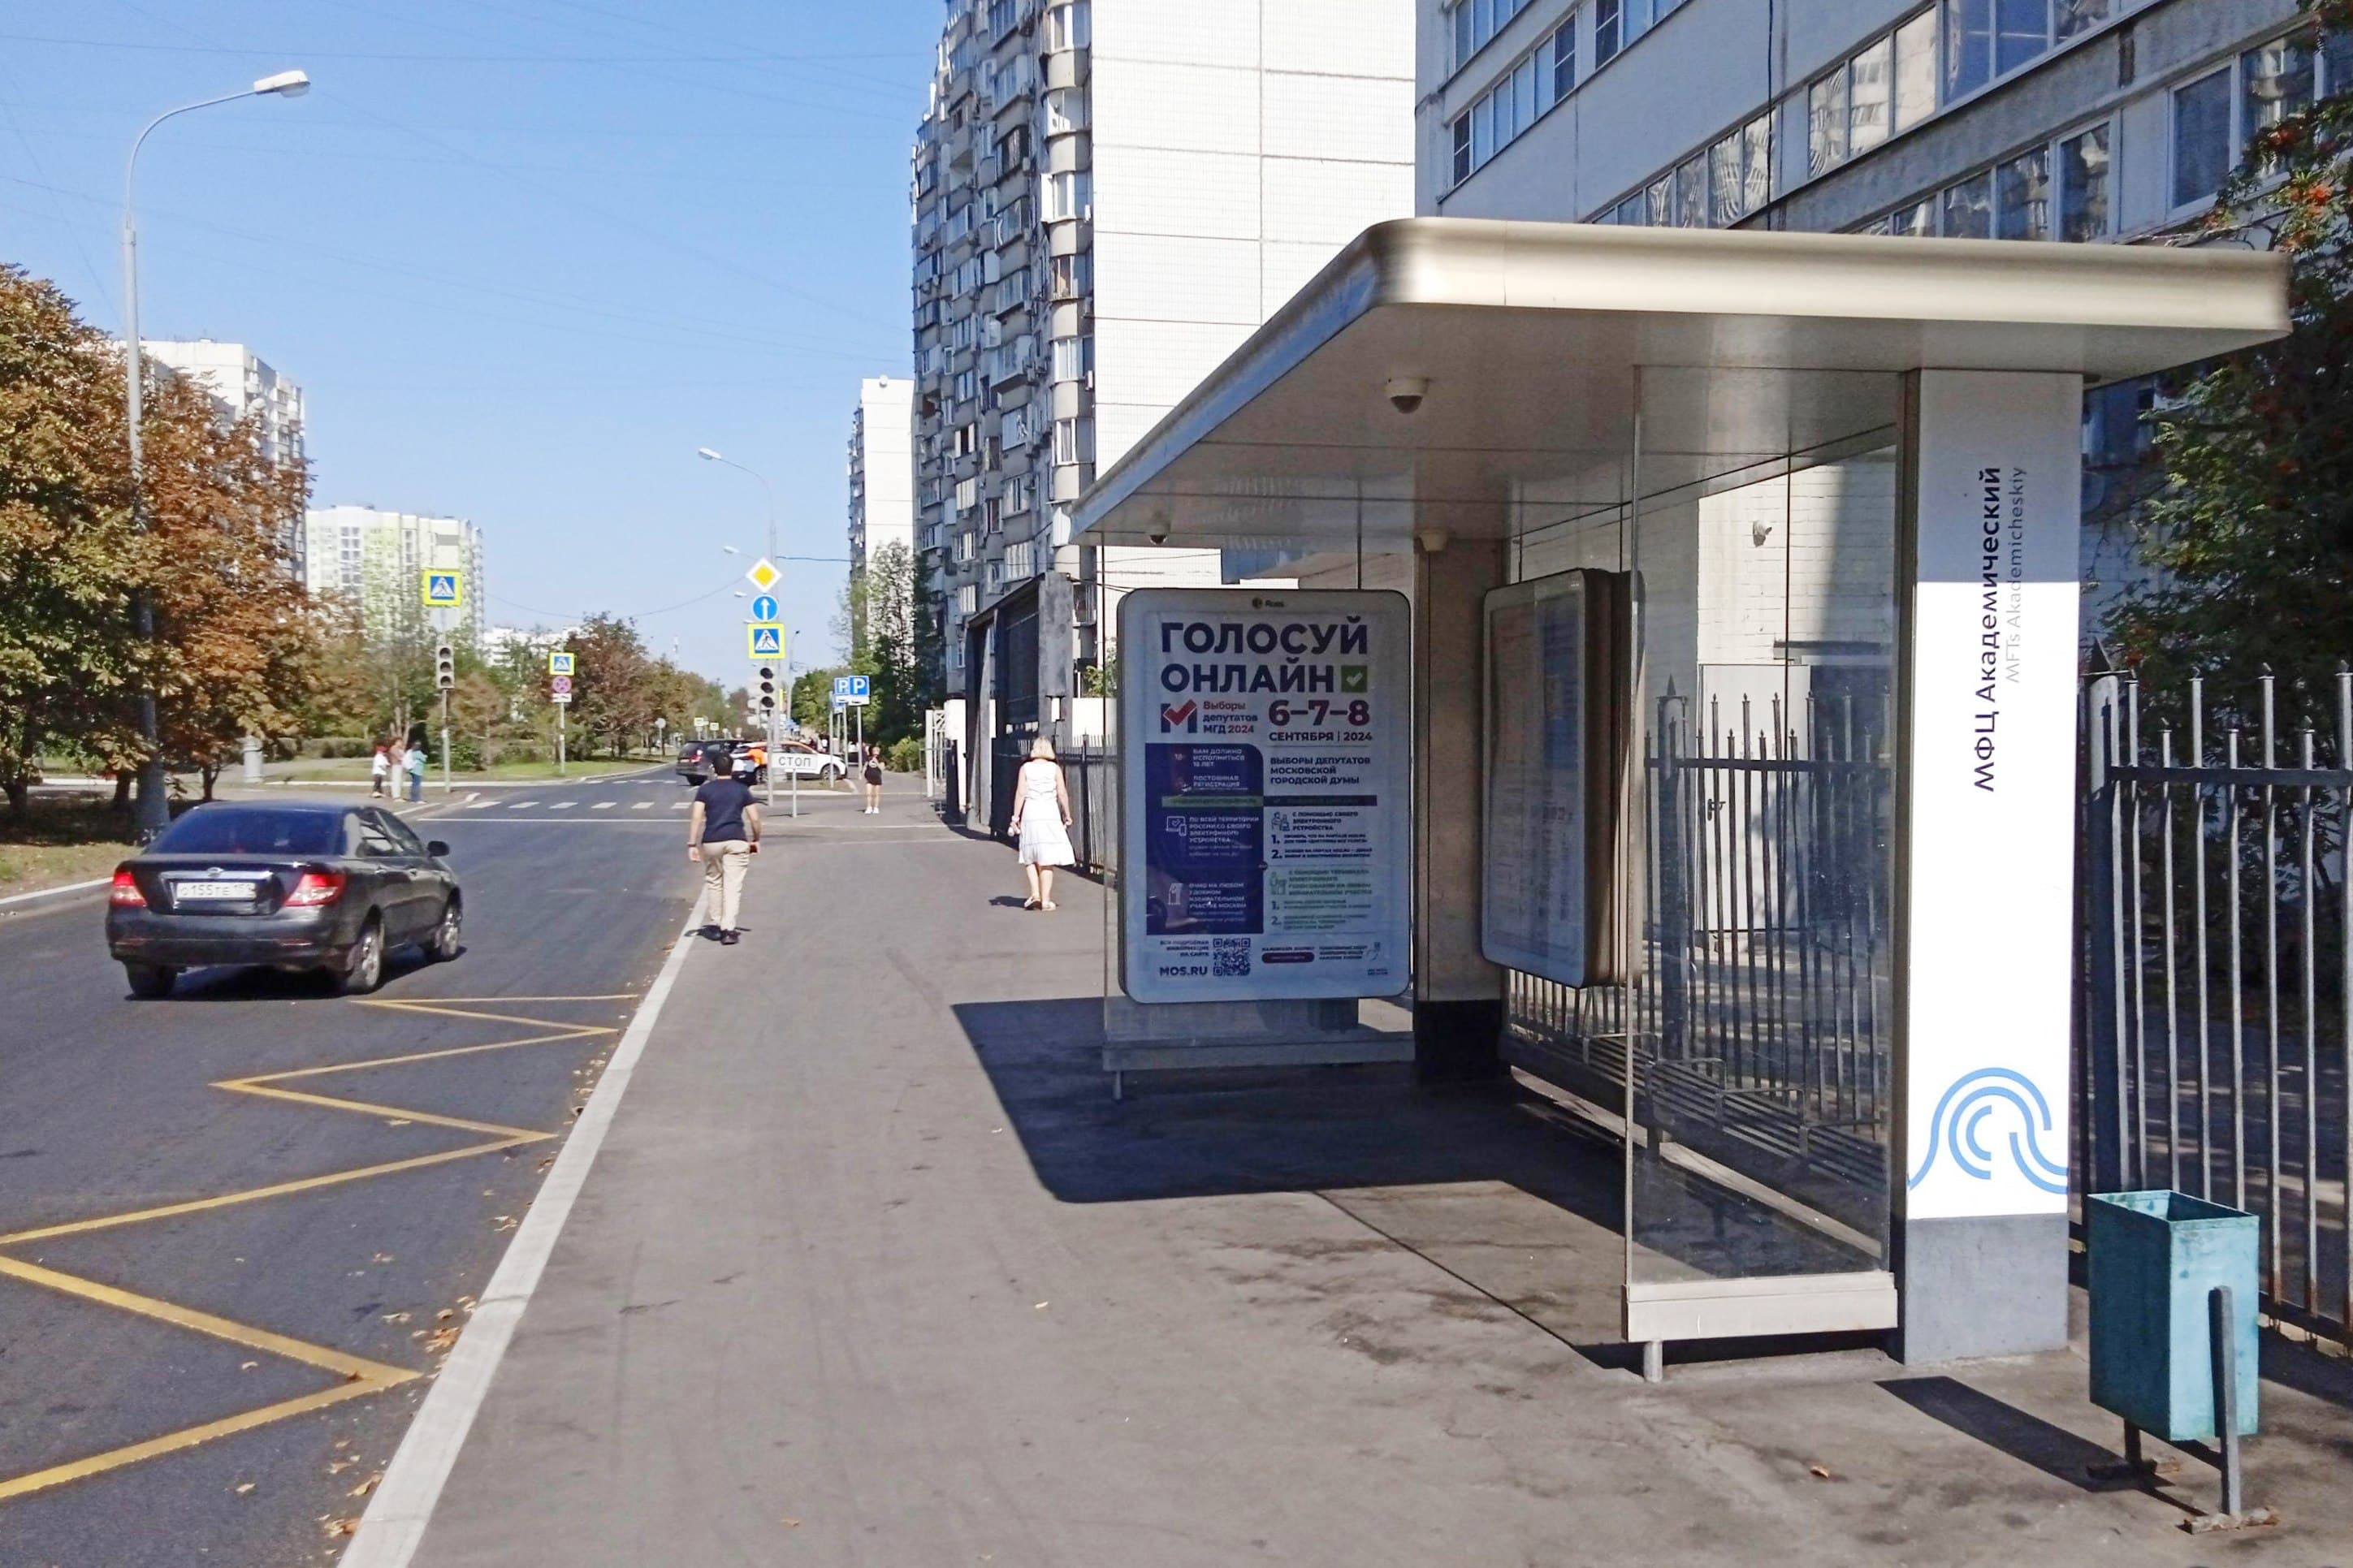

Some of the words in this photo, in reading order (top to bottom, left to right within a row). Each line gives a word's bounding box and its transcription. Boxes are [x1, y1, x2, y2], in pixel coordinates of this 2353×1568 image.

[2005, 467, 2027, 628] Akademicheskiy
[1975, 467, 2000, 702] Академический
[1160, 616, 1369, 654] ГОЛОСУЙ
[2005, 633, 2021, 684] MFTs
[1160, 656, 1334, 693] ОНЛАЙН
[853, 677, 866, 694] P
[1203, 701, 1247, 711] Выборы
[1203, 714, 1259, 724] депутатов
[1203, 724, 1226, 735] МГД
[1227, 724, 1255, 734] 2024
[1269, 731, 1334, 741] СЕНТЯБРЯ
[1343, 731, 1373, 741] 2024
[1974, 711, 2000, 793] МФЦ
[778, 756, 811, 767] СТОП
[1269, 757, 1313, 765] ВЫБОРЫ
[1315, 757, 1371, 765] ДЕПУТАТОВ
[1269, 766, 1336, 774] МОСКОВСКОЙ
[1269, 775, 1328, 785] ГОРОДСКОЙ
[1330, 777, 1360, 785] ДУМЫ
[1271, 834, 1280, 844] 1.
[1271, 849, 1282, 859] 2.
[1159, 966, 1208, 976] MOS.RU
